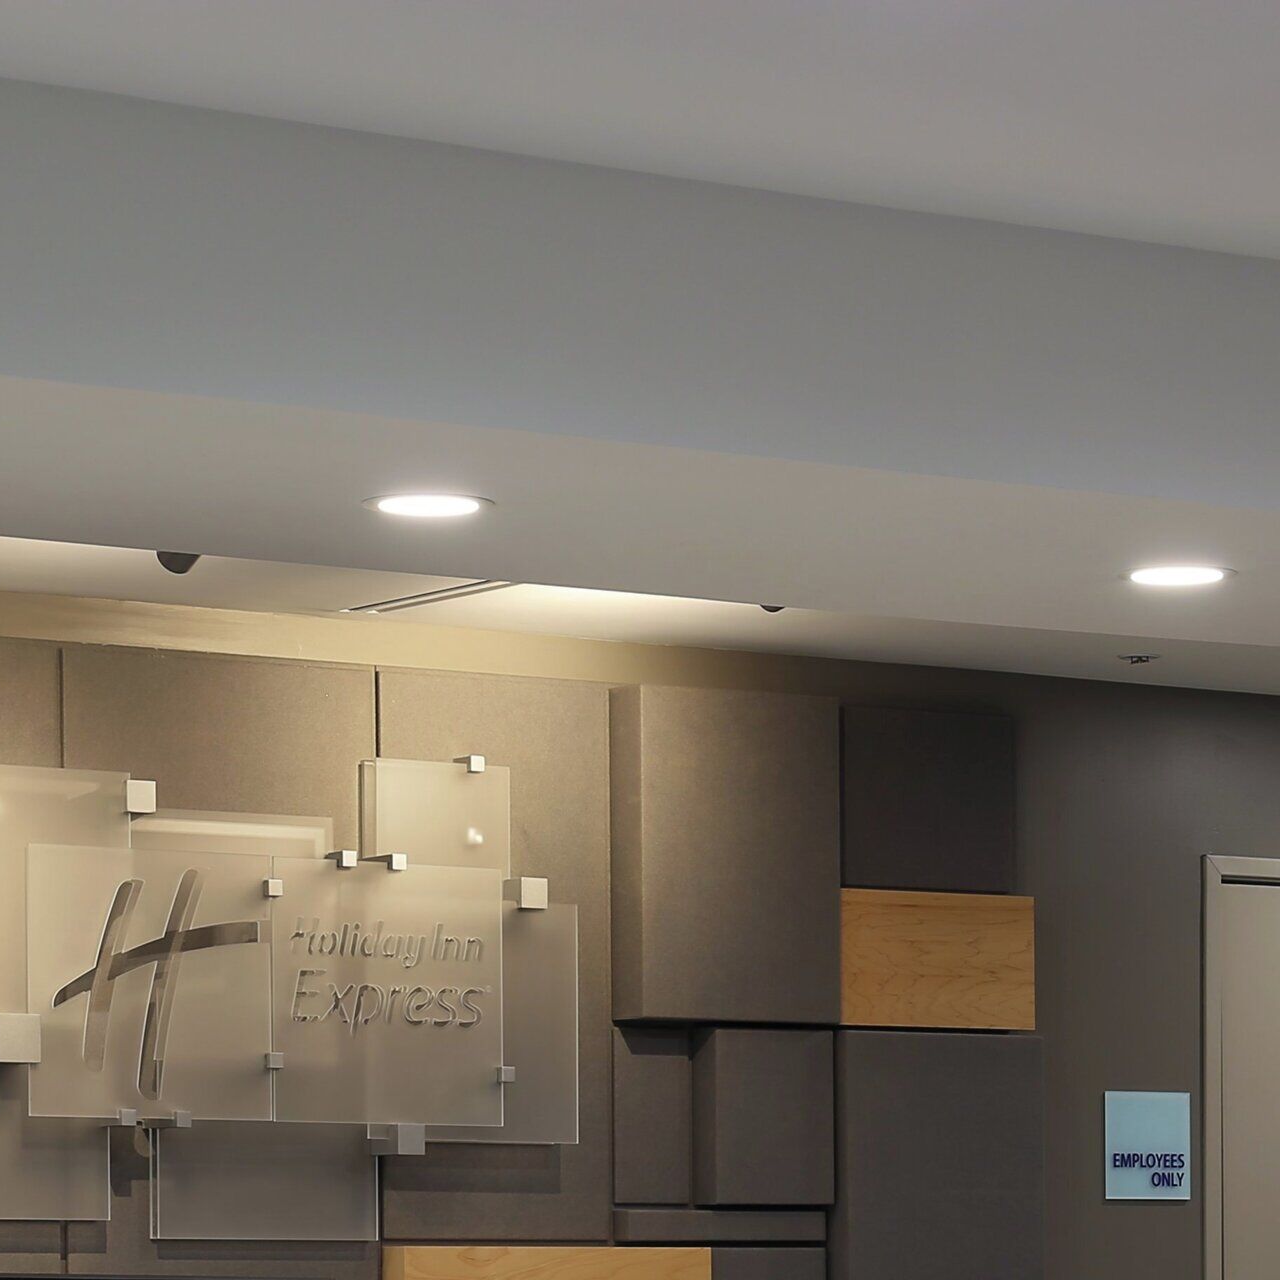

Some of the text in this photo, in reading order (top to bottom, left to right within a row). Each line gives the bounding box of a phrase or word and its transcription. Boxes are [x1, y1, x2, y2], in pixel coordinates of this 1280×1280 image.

[289, 916, 484, 969] Holiday Inn
[290, 968, 485, 1038] Express
[1112, 1153, 1185, 1169] EMPLOYEES
[1151, 1171, 1185, 1187] ONLY
